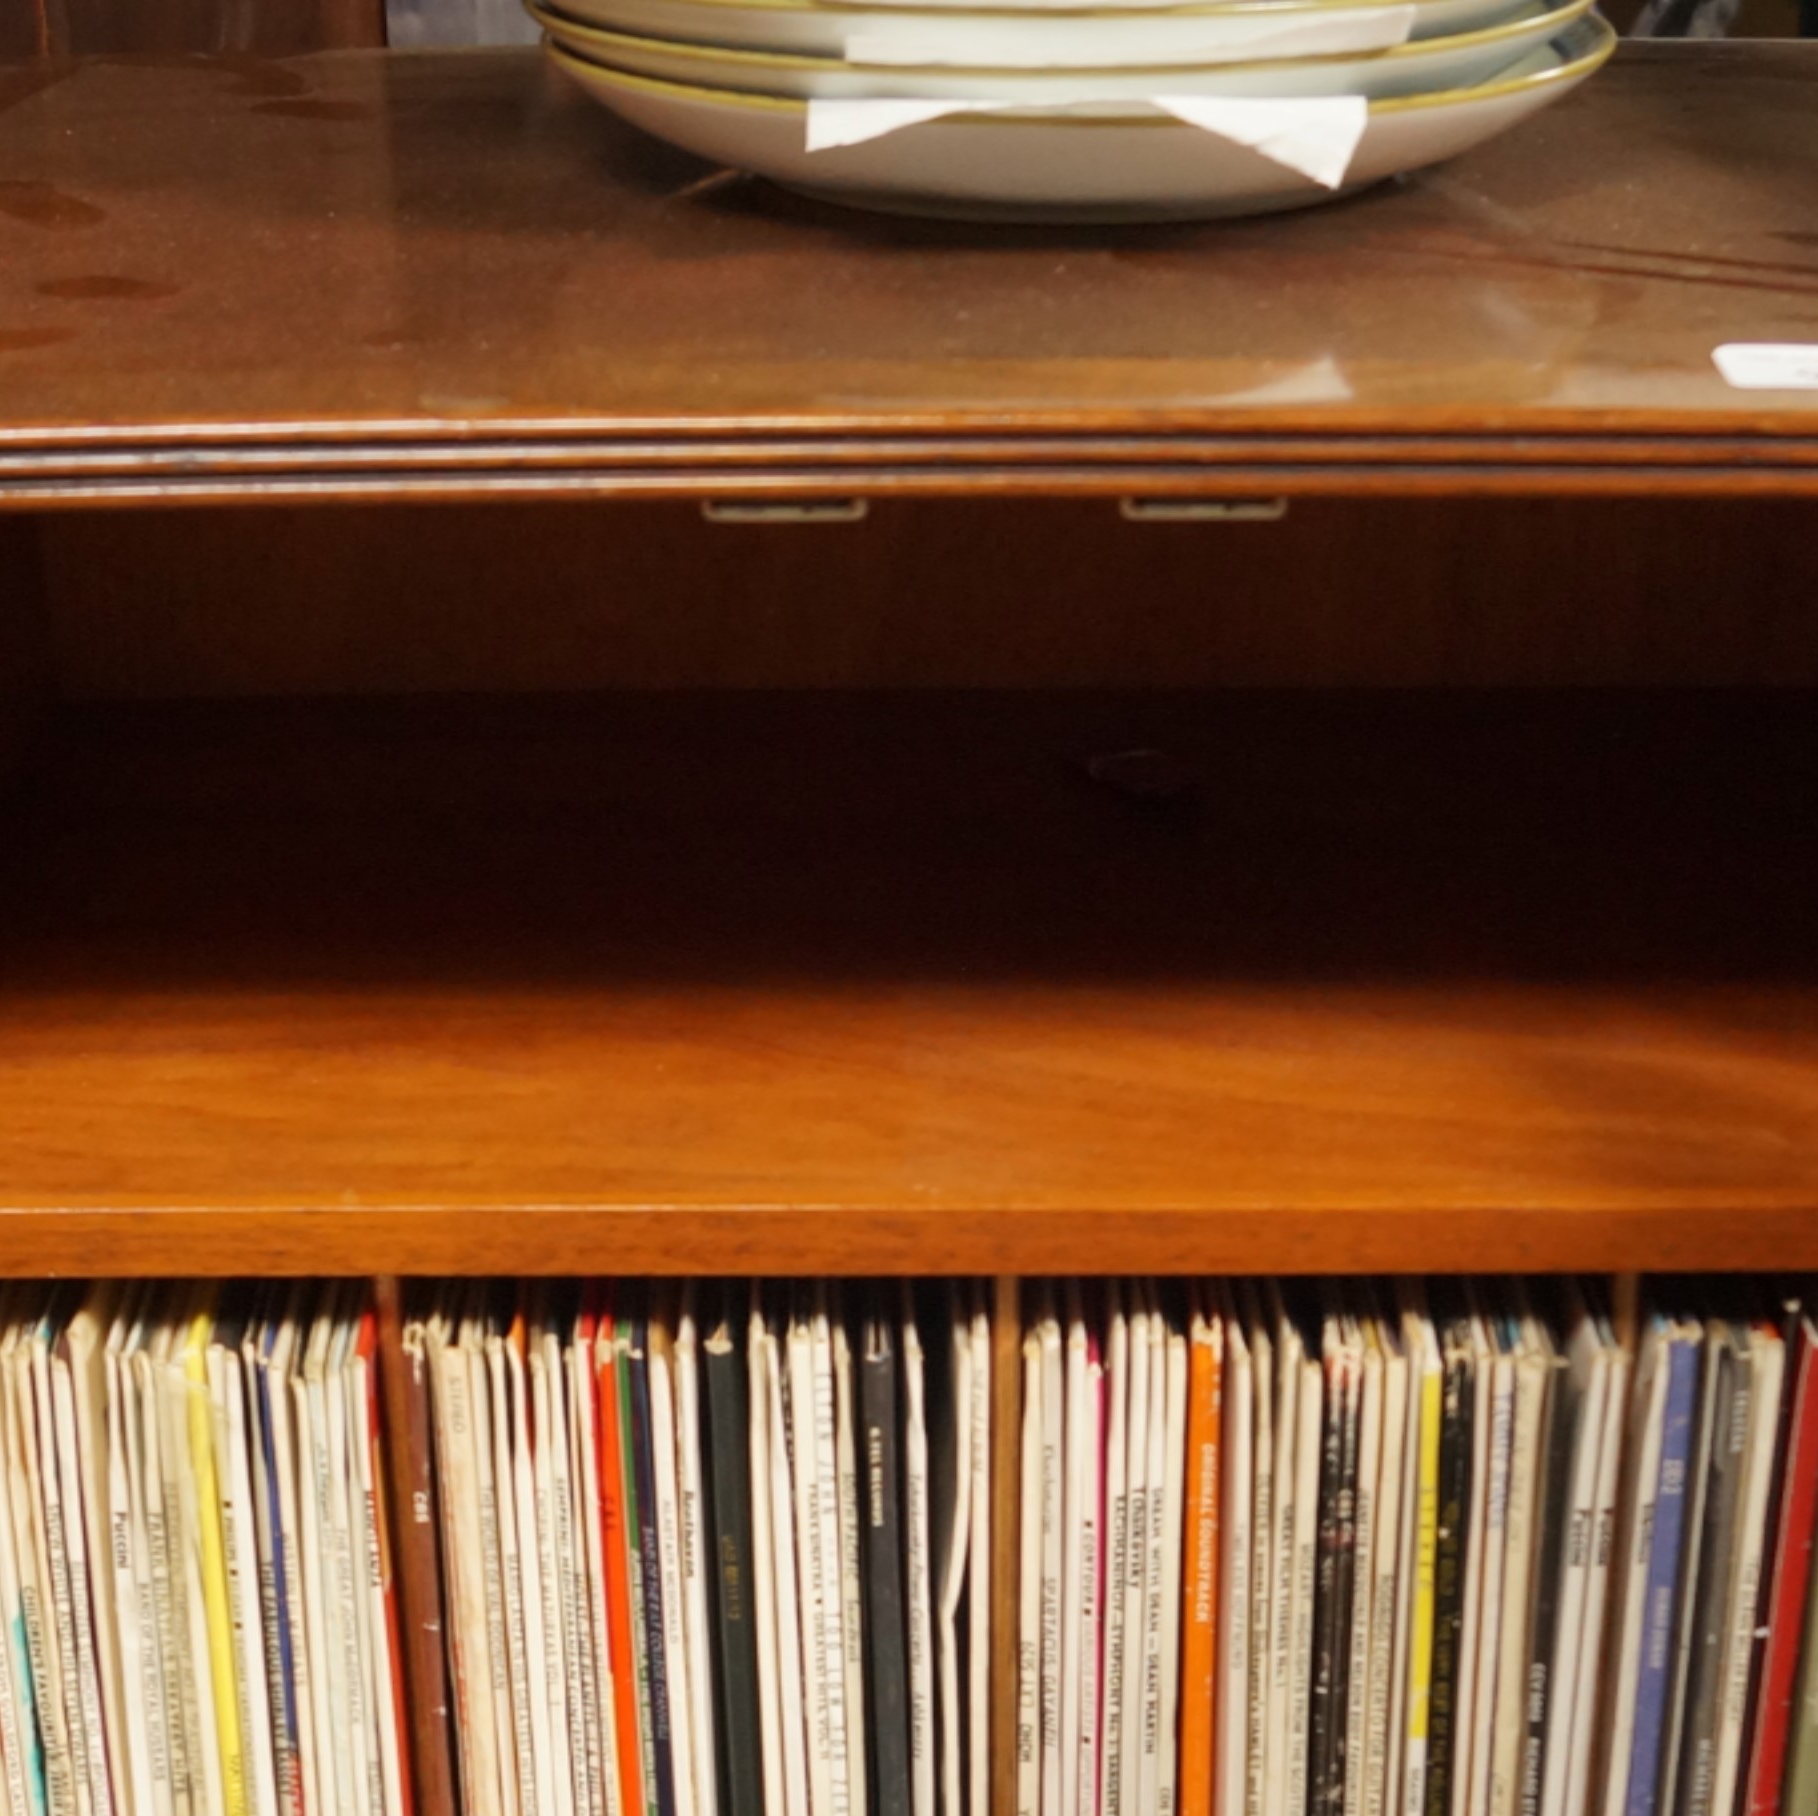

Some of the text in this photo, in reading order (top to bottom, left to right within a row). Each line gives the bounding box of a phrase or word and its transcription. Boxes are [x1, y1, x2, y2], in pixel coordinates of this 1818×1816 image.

[449, 1376, 466, 1434] STEREO
[114, 1512, 130, 1569] Puccini
[682, 1491, 695, 1578] Beethoven
[1125, 1487, 1145, 1588] Tchaikovsky
[1195, 1444, 1215, 1622] ORIGINAL SOUNDTRACK
[259, 1560, 275, 1586] THE
[262, 1592, 283, 1673] FABULOUS
[1146, 1654, 1159, 1694] DEAN
[1144, 1701, 1157, 1754] MARTIN
